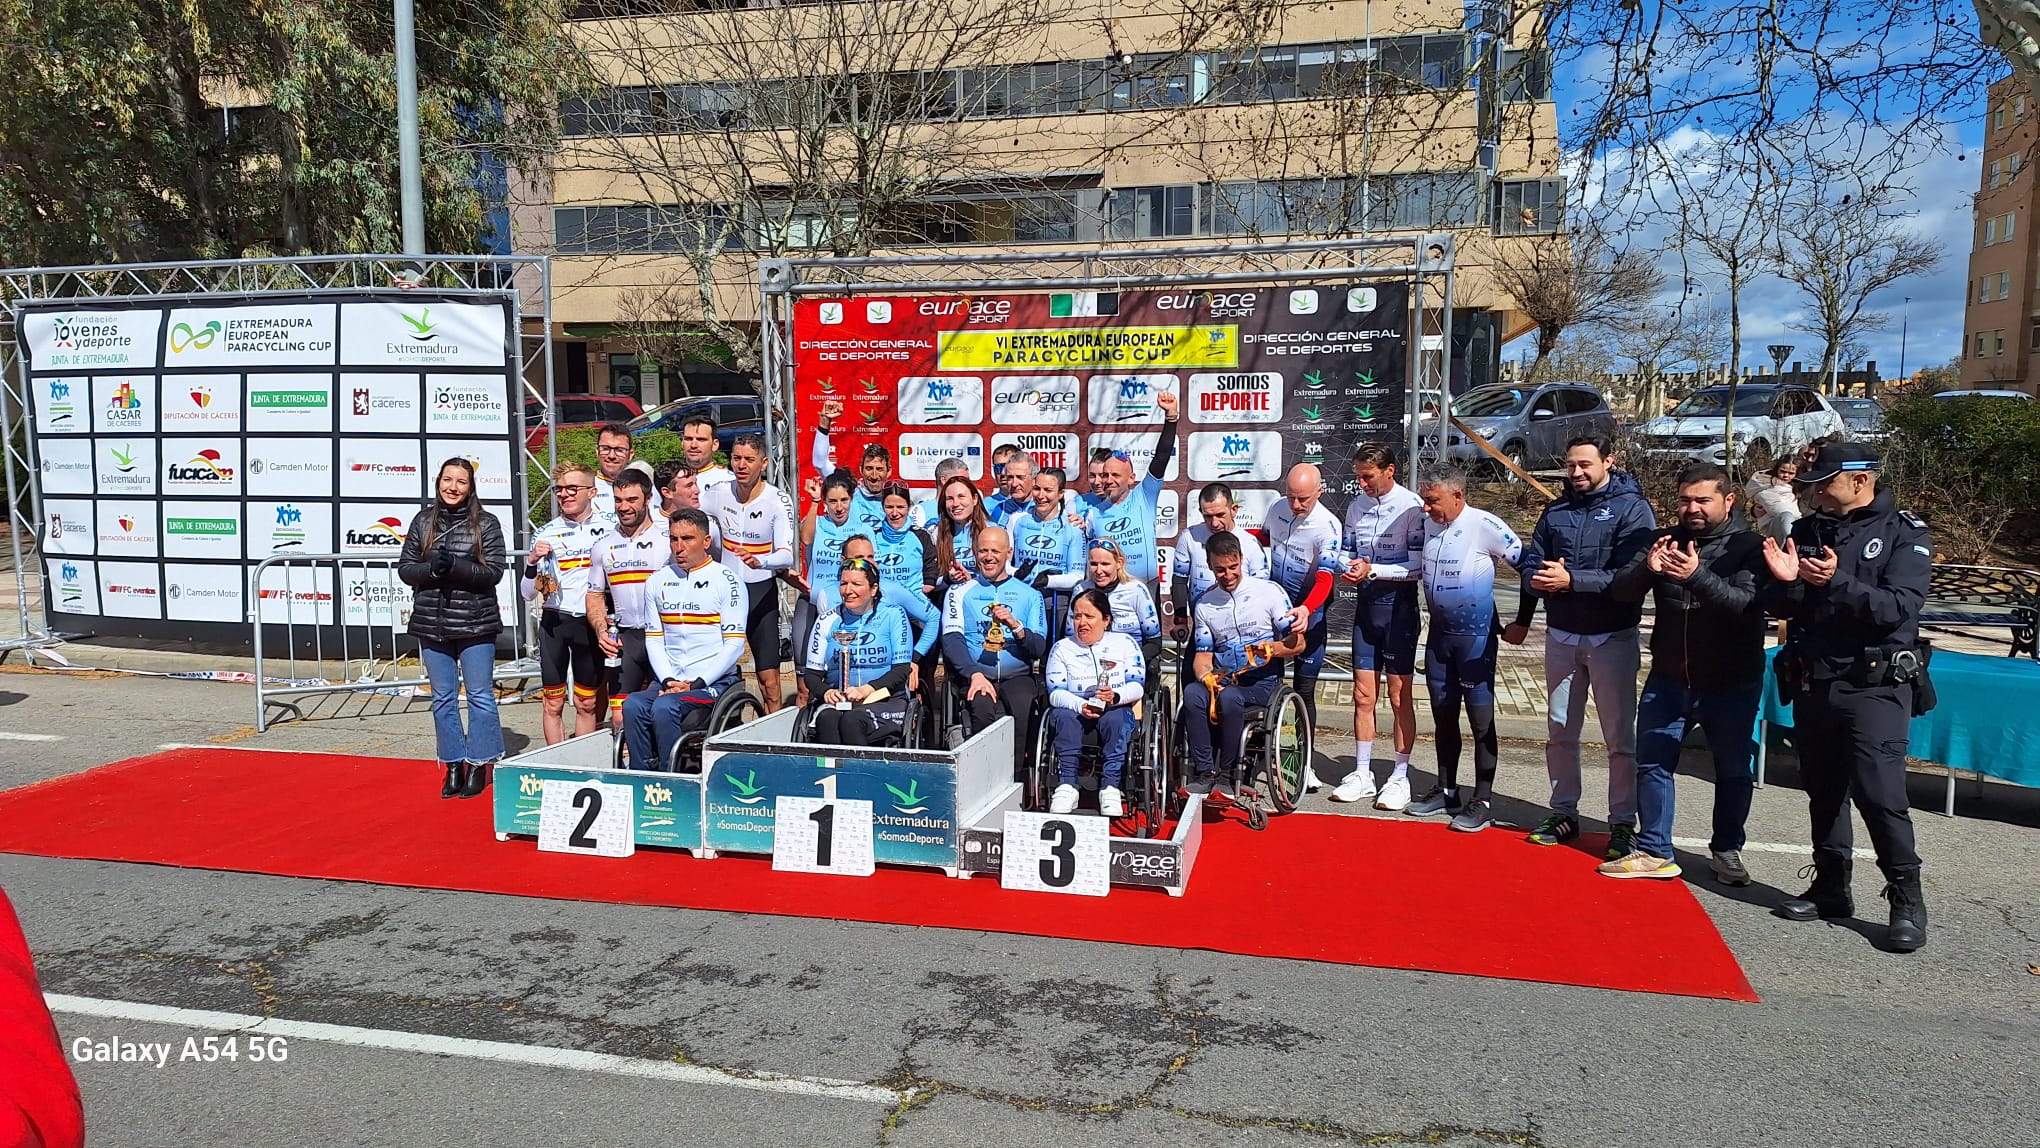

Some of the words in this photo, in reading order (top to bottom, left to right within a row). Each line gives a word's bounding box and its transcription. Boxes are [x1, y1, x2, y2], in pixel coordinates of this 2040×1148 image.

[1210, 308, 1256, 318] SPORT
[230, 318, 313, 329] EXTREMADURA
[968, 315, 1010, 324] SPORT
[228, 330, 289, 341] EUROPEAN
[996, 336, 1008, 349] VI
[1012, 335, 1101, 349] EXTREMADURA
[1106, 332, 1174, 347] EUROPEAN
[1243, 330, 1324, 344] DIRECCIÓN
[1326, 328, 1400, 341] GENERAL
[227, 342, 306, 352] PARACYCLING
[309, 341, 332, 351] CUP
[386, 343, 458, 354] Extremadura
[800, 338, 867, 349] DIRECCIÓN
[869, 340, 933, 350] GENERAL
[1266, 345, 1287, 355] DE
[1290, 343, 1373, 355] DEPORTES
[83, 353, 129, 364] EXTREMADURA
[819, 351, 841, 361] DE
[842, 351, 910, 361] DEPORTES
[993, 348, 1125, 363] PARACYCLING
[1135, 347, 1171, 360] CUP
[1293, 388, 1337, 396] Extremadura
[1345, 388, 1389, 396] Extremadura
[253, 395, 270, 405] JUNTA
[273, 395, 281, 403] DE
[282, 394, 326, 403] EXTREMADURA
[1200, 392, 1270, 411] DEPORTE
[1038, 404, 1075, 412] SPORT
[106, 409, 141, 420] CASAR
[460, 413, 501, 422] EXTREMADURA
[1292, 423, 1335, 431] Extremadura
[1343, 423, 1388, 431] Extremadura
[916, 446, 964, 458] Interreg
[269, 462, 302, 471] Camden
[304, 462, 328, 471] Motor
[371, 464, 384, 472] FC
[385, 464, 416, 472] eventos
[101, 474, 151, 484] Extremadura
[168, 521, 185, 532] JUNTA
[186, 521, 194, 530] DE
[195, 521, 234, 531] EXTREMADURA
[728, 528, 760, 539] Cofidis
[1018, 549, 1064, 561] HYUNDAI
[612, 559, 648, 569] Cofidis
[186, 588, 216, 597] Camden
[217, 589, 240, 598] Motor
[722, 569, 741, 608] Cofidis
[662, 601, 700, 611] Cofidis
[811, 623, 821, 655] Koryo
[868, 655, 888, 664] Car
[569, 788, 603, 848] 2
[716, 820, 776, 833] #SomosDeport
[809, 804, 834, 867] 1
[878, 831, 944, 845] #SomosDeporte
[1039, 820, 1077, 887] 3
[1132, 867, 1174, 878] SPORT
